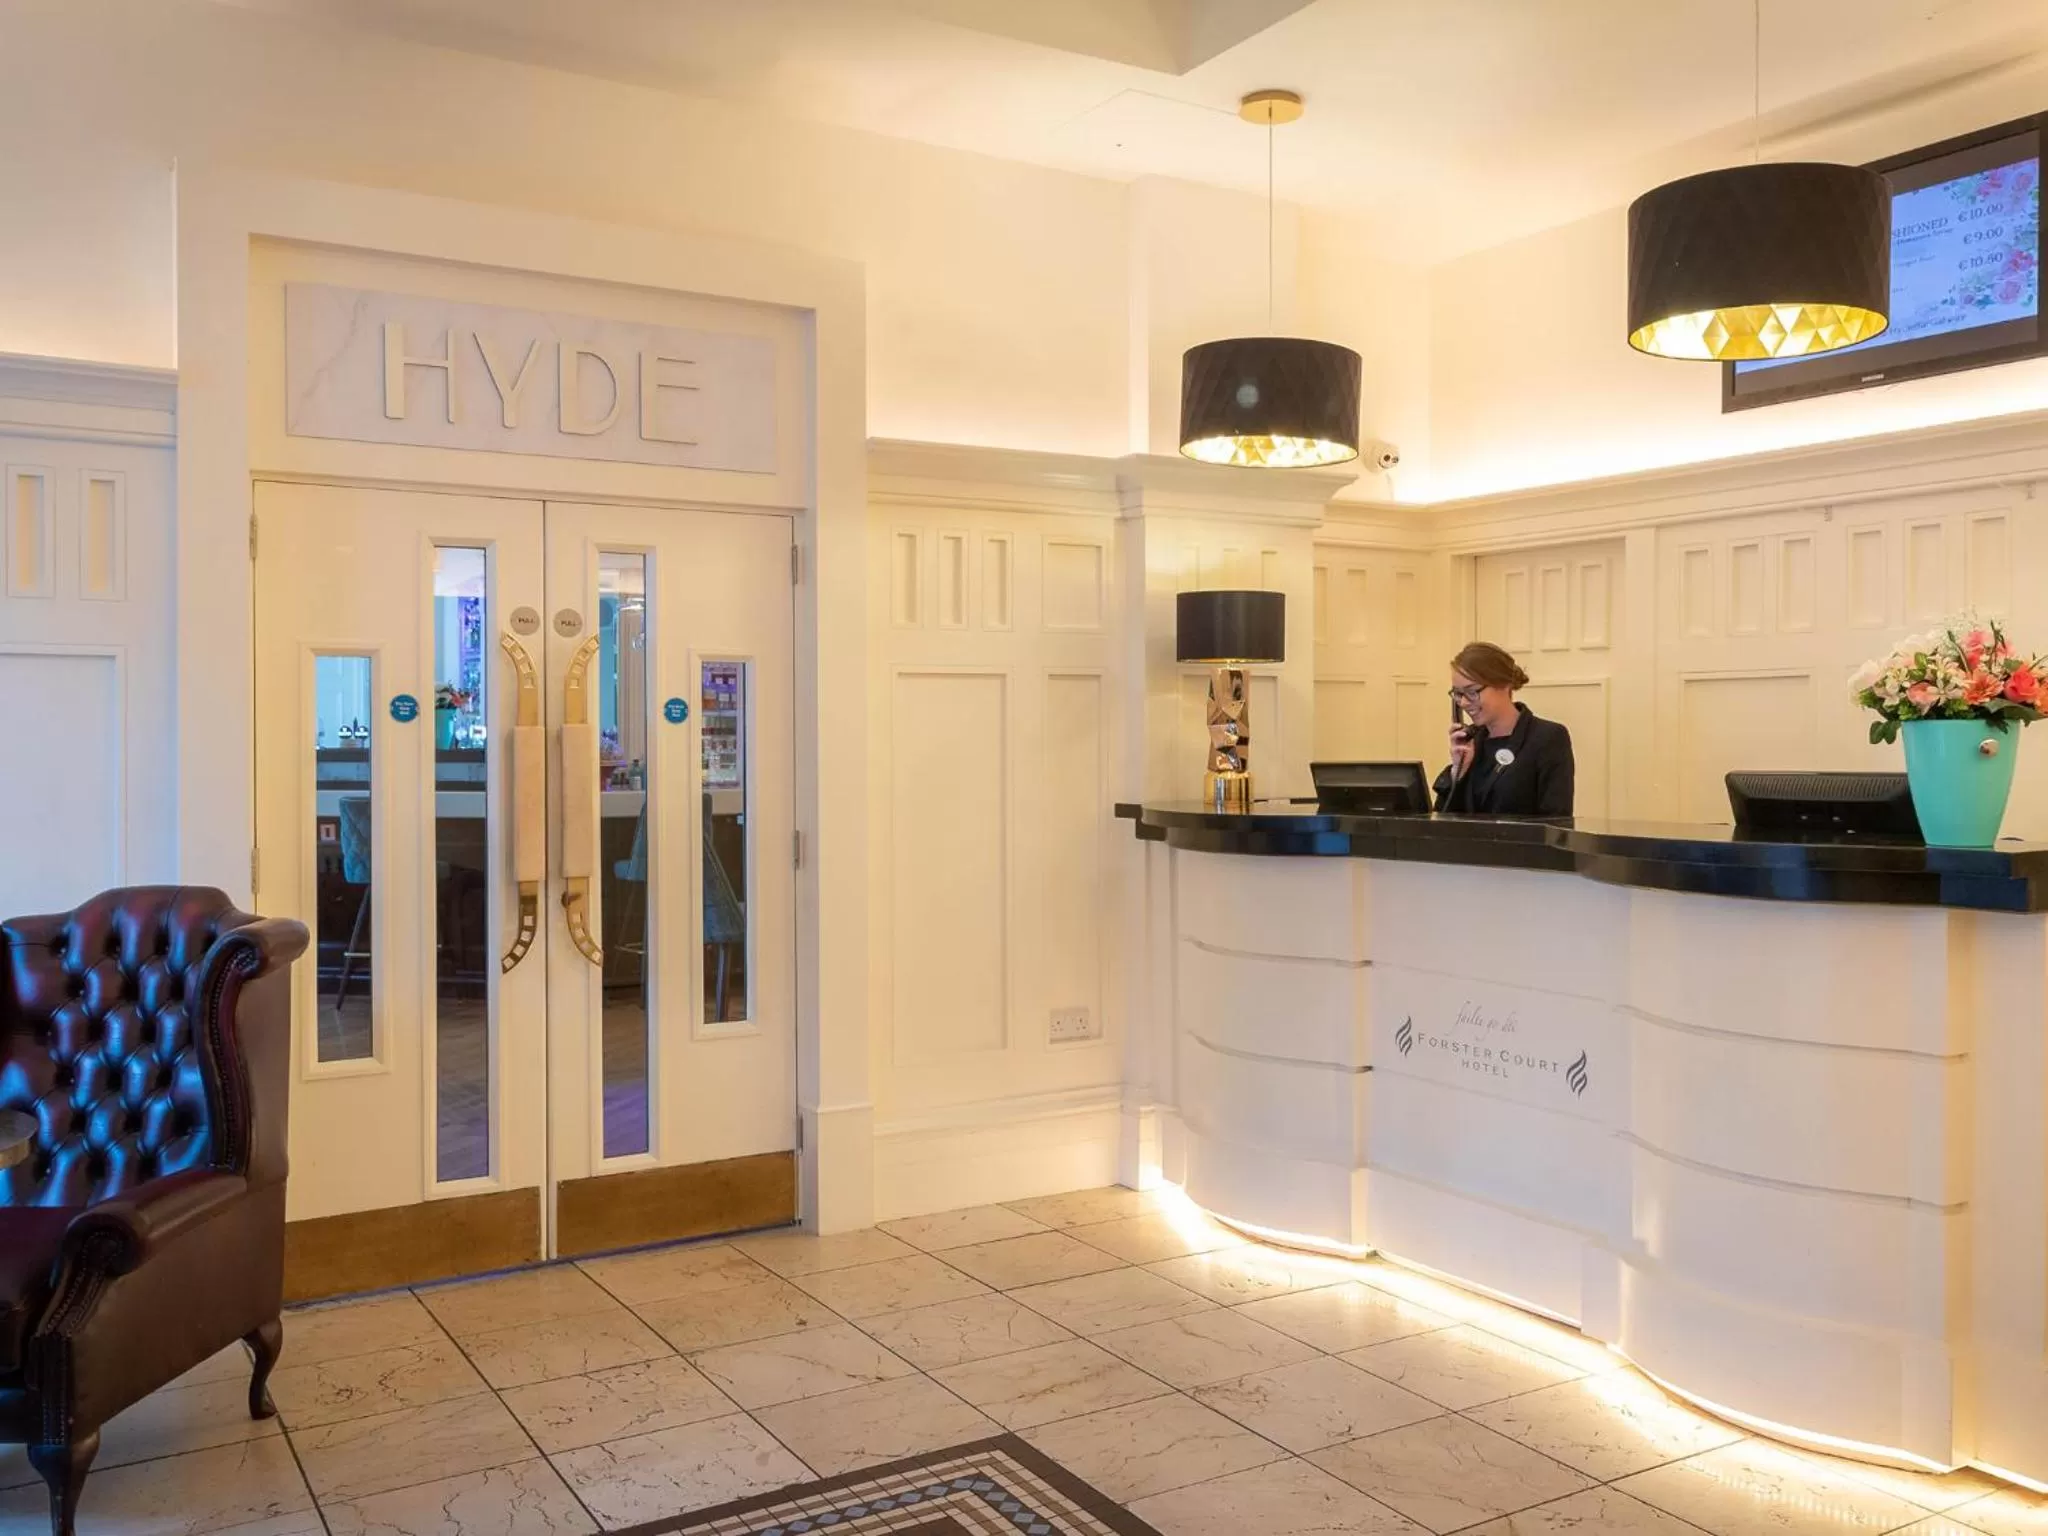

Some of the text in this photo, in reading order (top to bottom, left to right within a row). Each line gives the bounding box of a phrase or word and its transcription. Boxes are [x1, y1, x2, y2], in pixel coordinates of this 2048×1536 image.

[1964, 226, 2004, 244] €9.00
[382, 319, 700, 446] HYDE
[1417, 1032, 1560, 1073] FORSTER COURT
[1462, 1059, 1509, 1079] HOTEL
